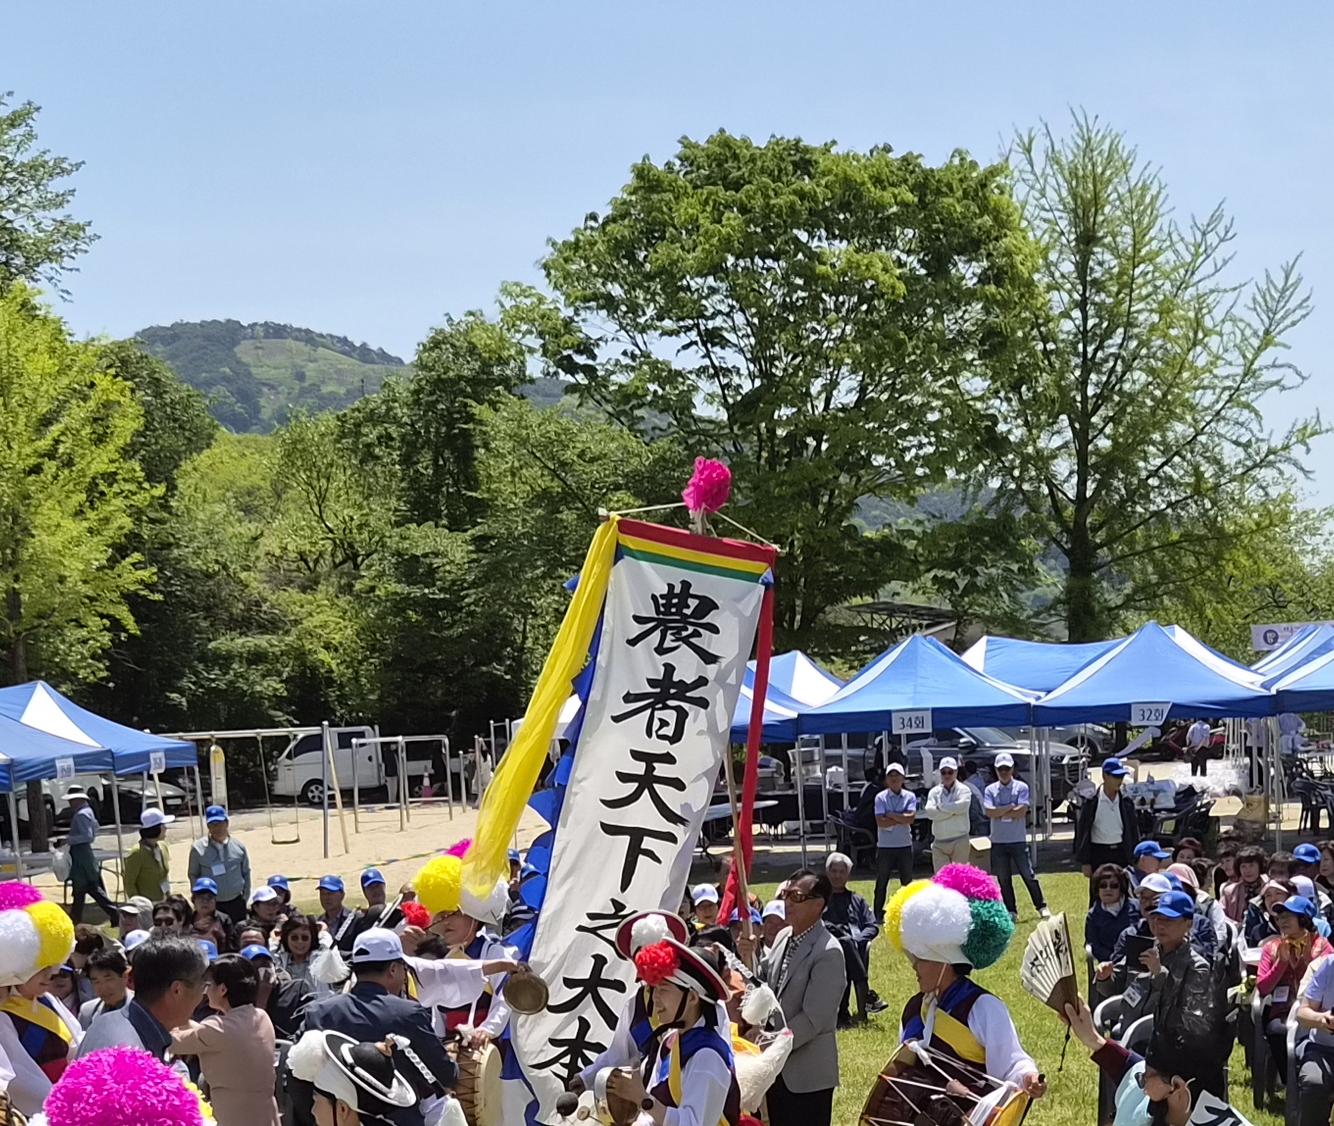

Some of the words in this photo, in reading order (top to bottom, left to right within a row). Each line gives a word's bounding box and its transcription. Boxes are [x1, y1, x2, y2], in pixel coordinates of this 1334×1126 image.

[1138, 708, 1164, 721] 32회
[898, 716, 924, 730] 34회
[528, 579, 726, 1094] 農者天下之大本
